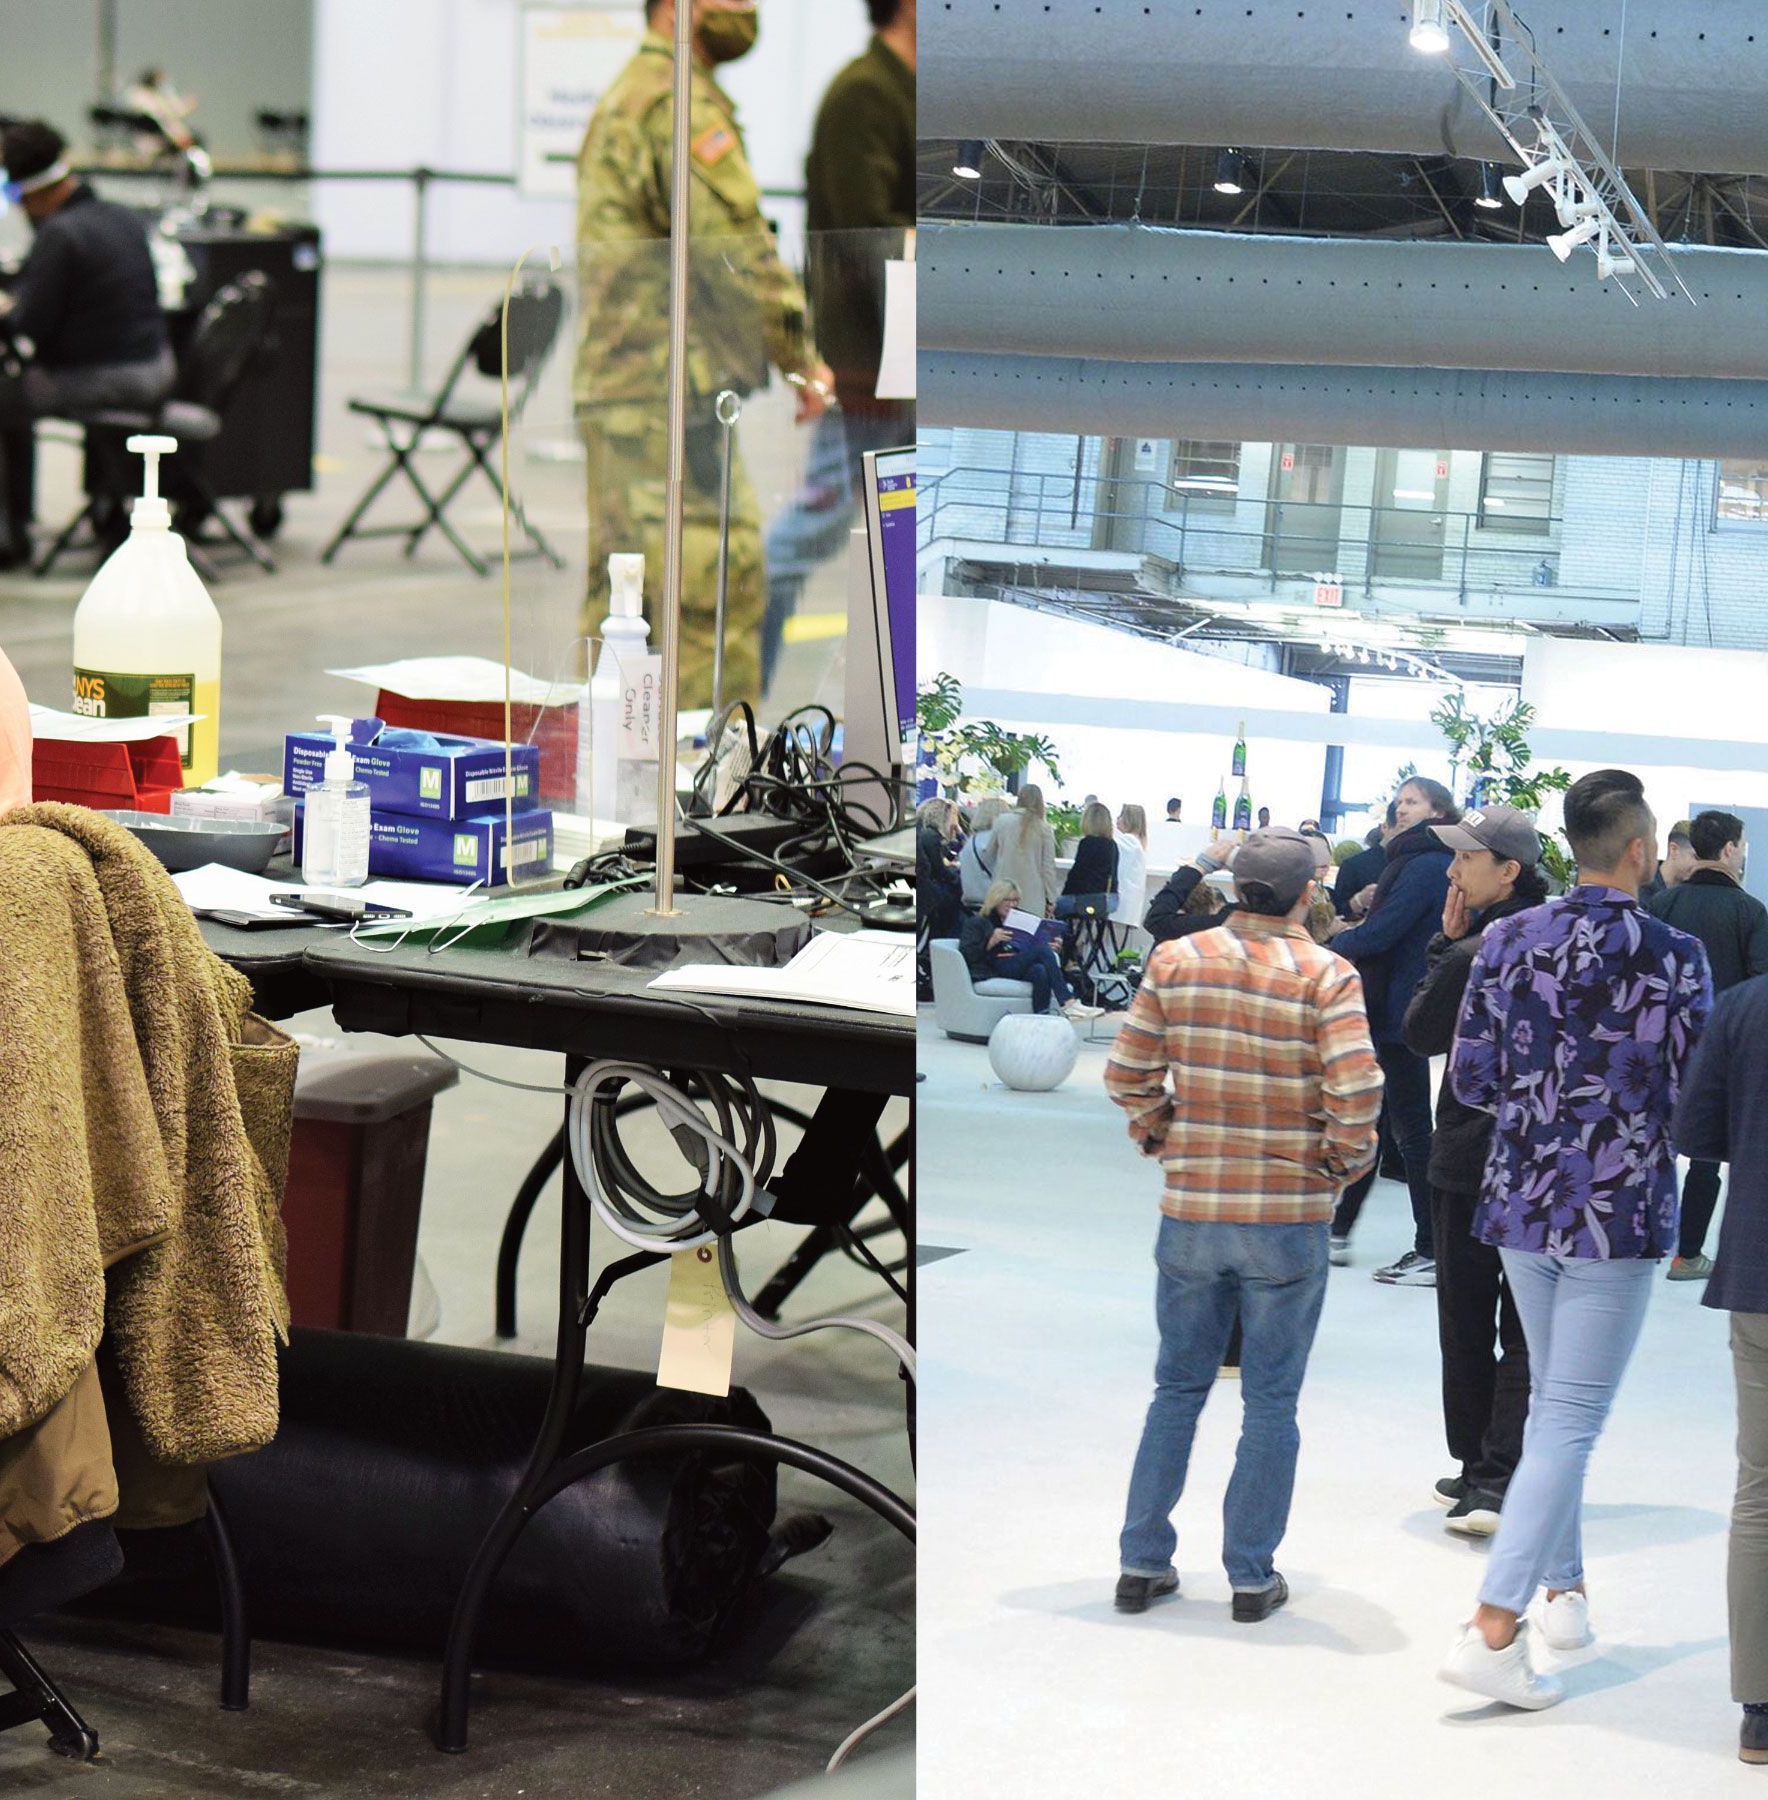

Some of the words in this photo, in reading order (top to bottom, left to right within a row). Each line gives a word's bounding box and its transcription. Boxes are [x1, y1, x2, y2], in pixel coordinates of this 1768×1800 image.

[622, 688, 637, 731] Only
[641, 673, 653, 745] Cleaner
[352, 754, 370, 765] Exam
[371, 758, 391, 768] Glove
[355, 766, 372, 775] Chemo
[373, 768, 390, 777] Tested
[422, 769, 439, 789] M
[374, 822, 395, 832] Exam
[396, 825, 420, 835] Glove
[378, 834, 398, 843] Chemo
[399, 836, 419, 845] Tested
[455, 836, 475, 857] M
